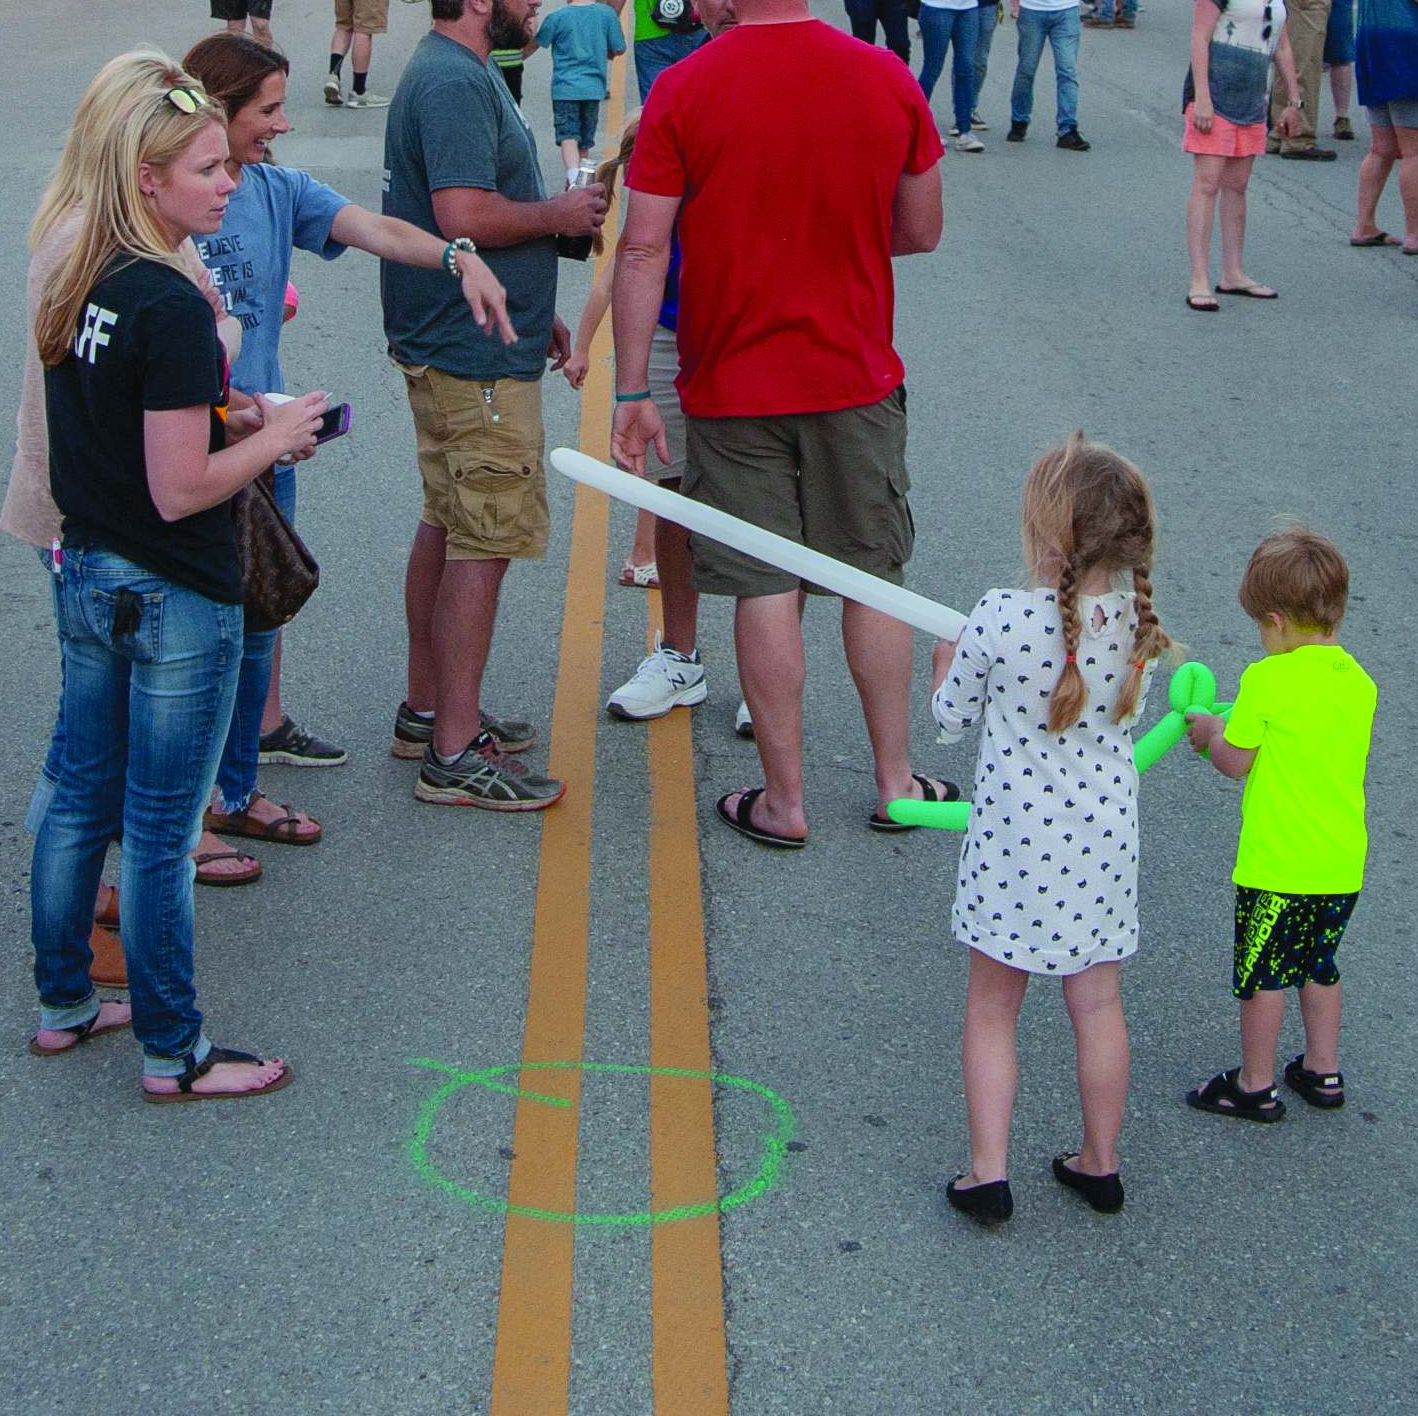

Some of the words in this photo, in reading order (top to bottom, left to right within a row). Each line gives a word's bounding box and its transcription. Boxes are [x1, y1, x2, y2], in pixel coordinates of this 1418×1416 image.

[198, 234, 244, 261] ELIEVE
[210, 264, 239, 287] ERE
[242, 261, 254, 279] IS
[74, 302, 118, 364] FF
[1241, 894, 1287, 987] ARMOUR
